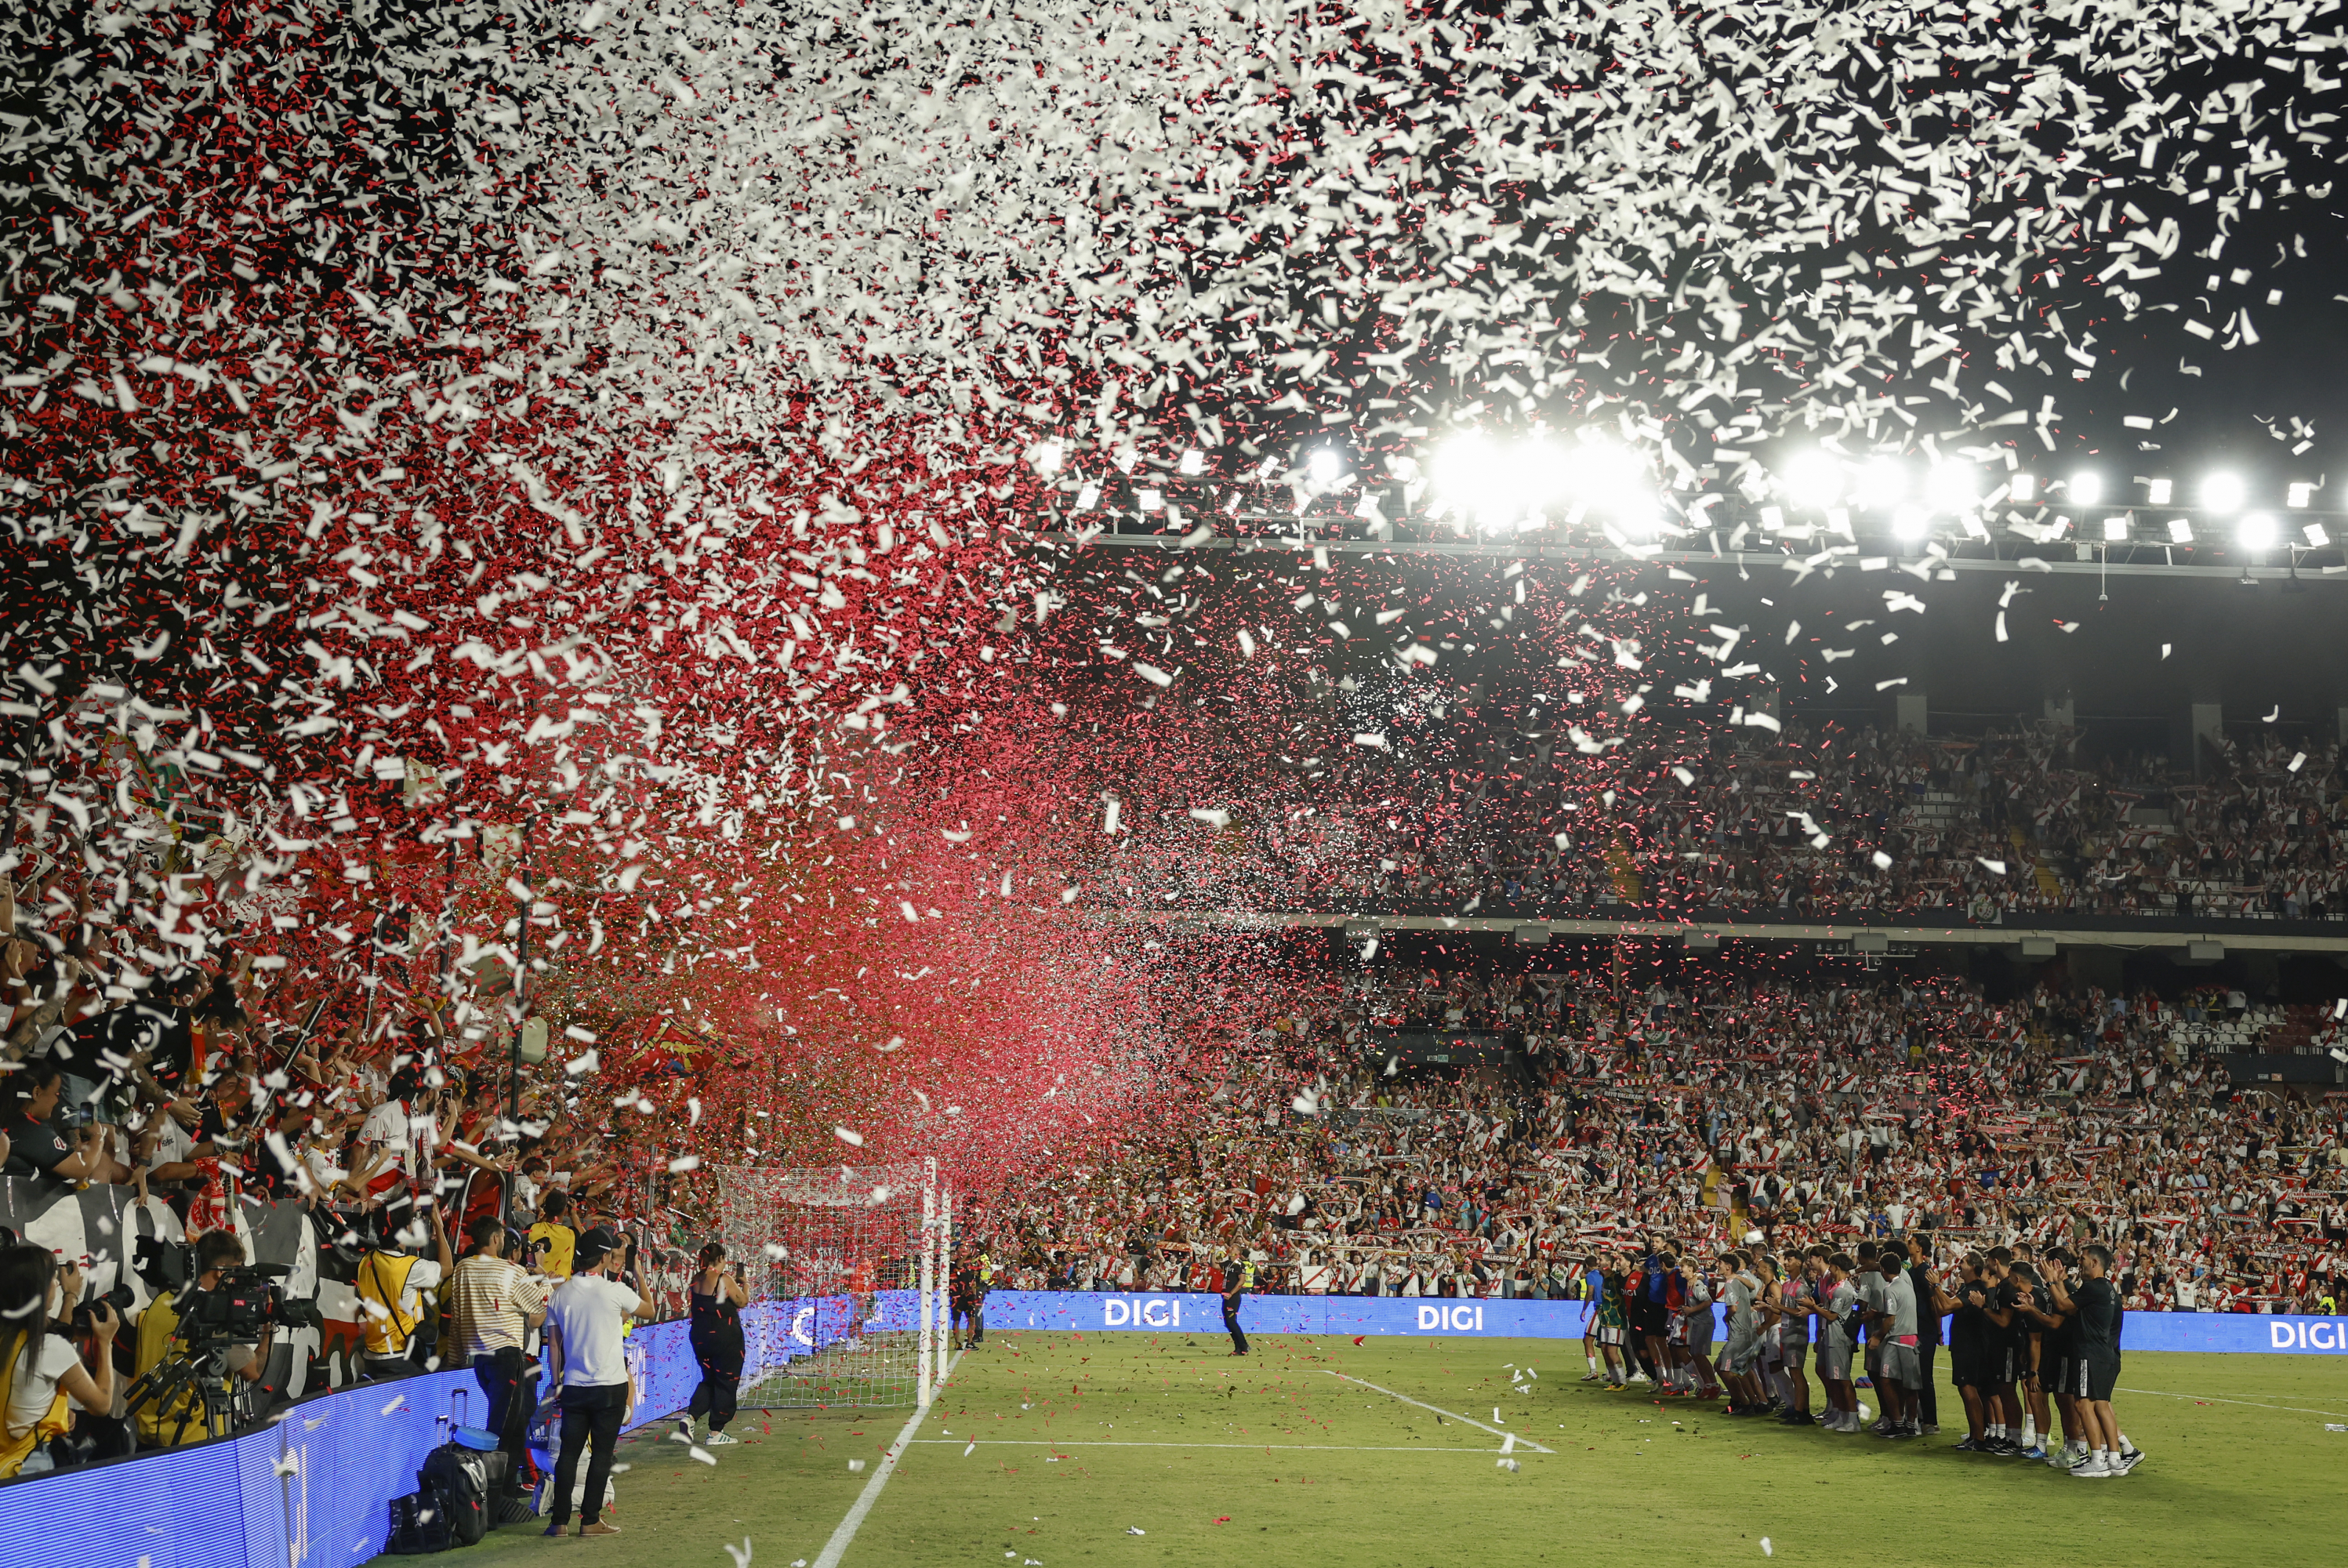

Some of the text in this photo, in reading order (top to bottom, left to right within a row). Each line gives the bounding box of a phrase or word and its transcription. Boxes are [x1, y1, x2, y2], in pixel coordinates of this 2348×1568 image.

[2240, 1272, 2262, 1280] Vallecano
[1620, 1288, 1637, 1297] DIGI
[251, 1304, 256, 1312] 4
[1105, 1299, 1179, 1327] DIGI
[1418, 1305, 1482, 1330] DIGI
[2270, 1322, 2346, 1349] DIGI
